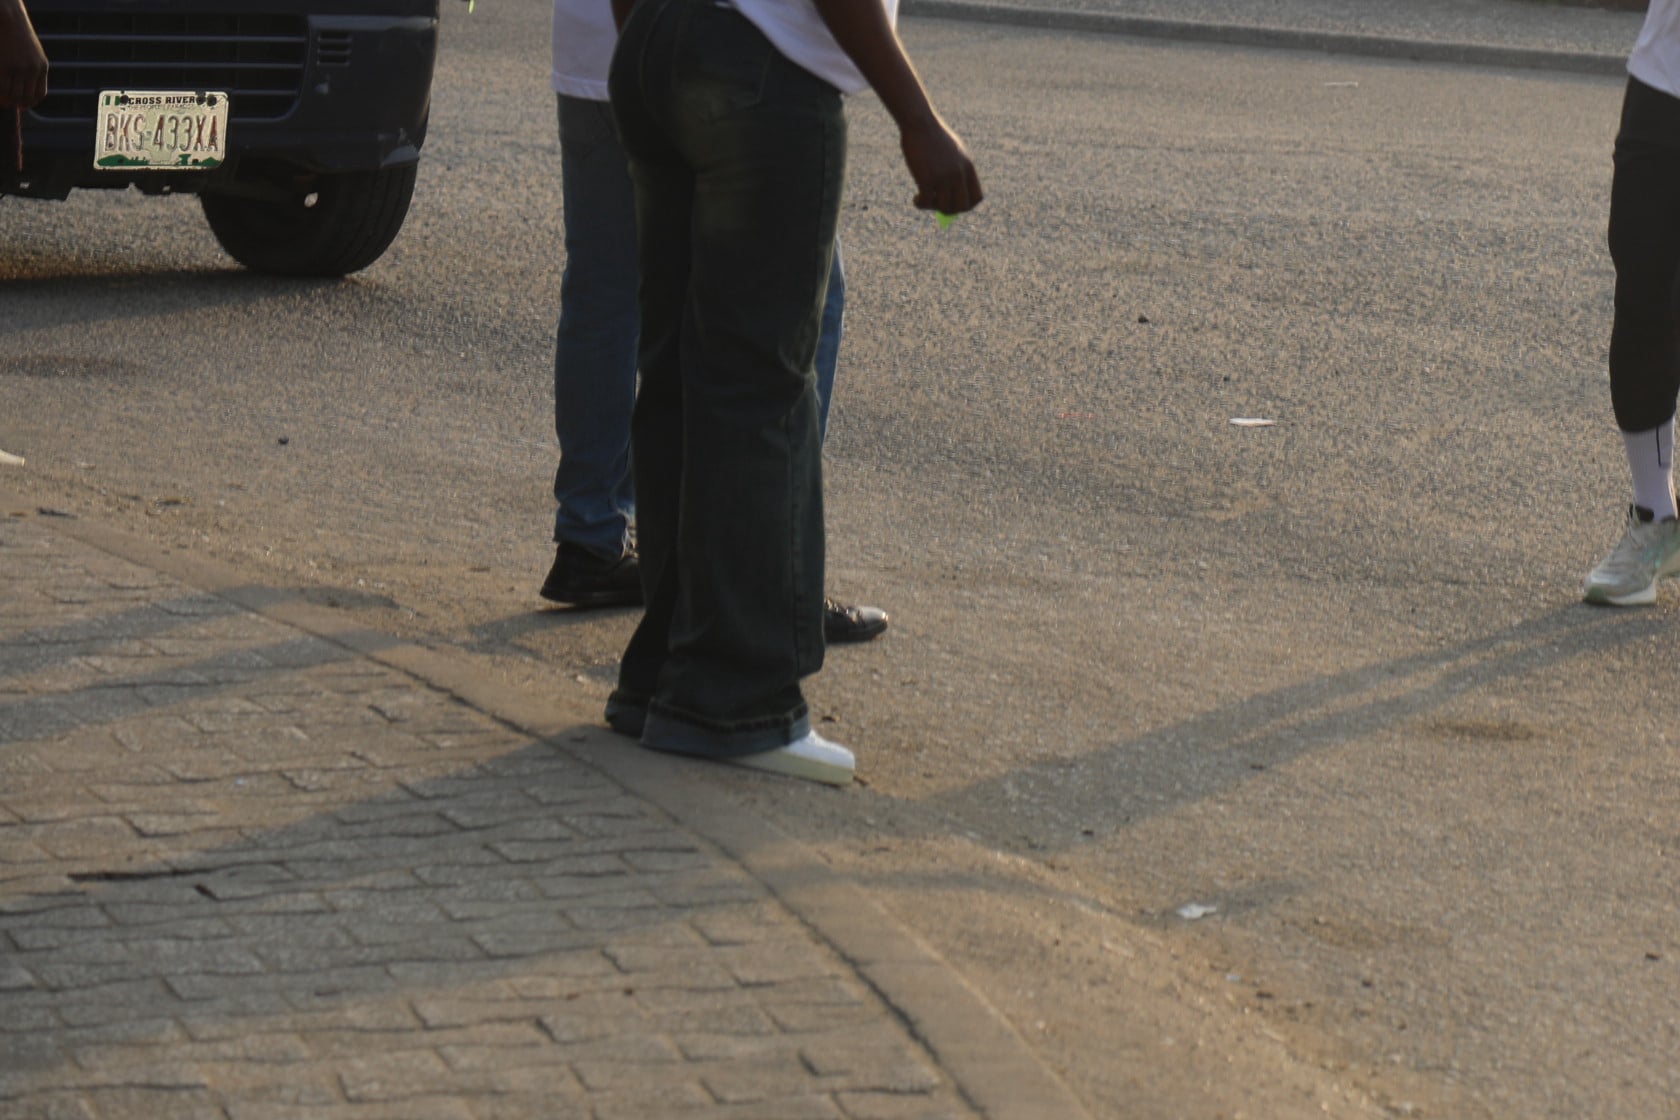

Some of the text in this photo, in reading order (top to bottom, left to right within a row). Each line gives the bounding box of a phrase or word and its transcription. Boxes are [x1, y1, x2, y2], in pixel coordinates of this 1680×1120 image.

[128, 96, 196, 105] CROSS RIVER
[104, 113, 219, 152] BKS-433XA
